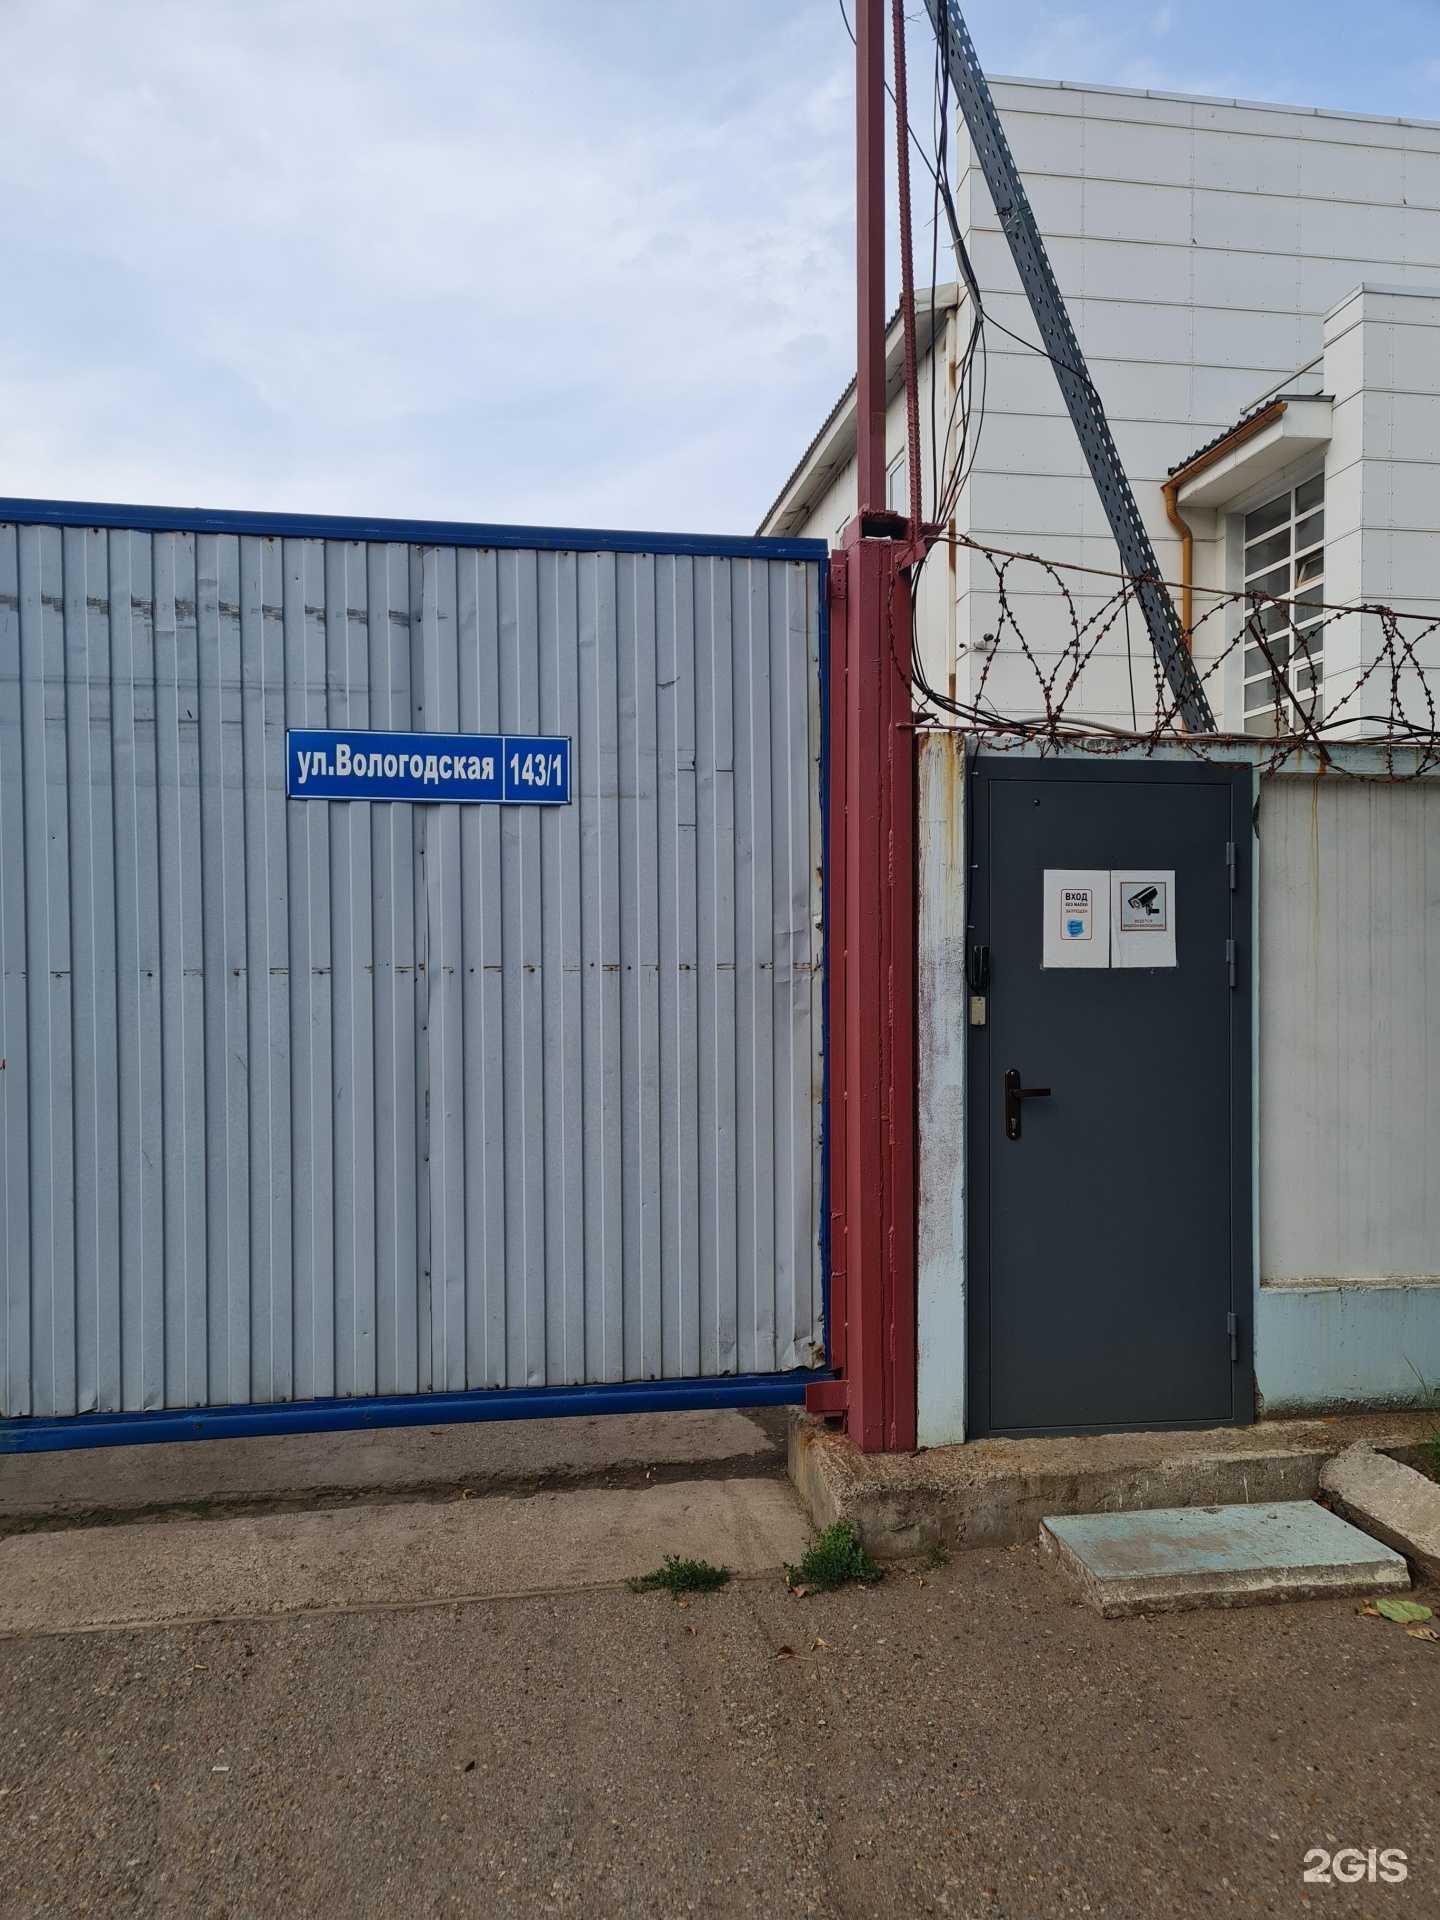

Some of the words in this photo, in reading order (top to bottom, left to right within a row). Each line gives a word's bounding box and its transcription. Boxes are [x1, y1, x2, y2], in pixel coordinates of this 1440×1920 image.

[297, 743, 495, 785] ул.Вологодская
[510, 753, 562, 786] 143/1
[1065, 892, 1088, 901] ВХОД
